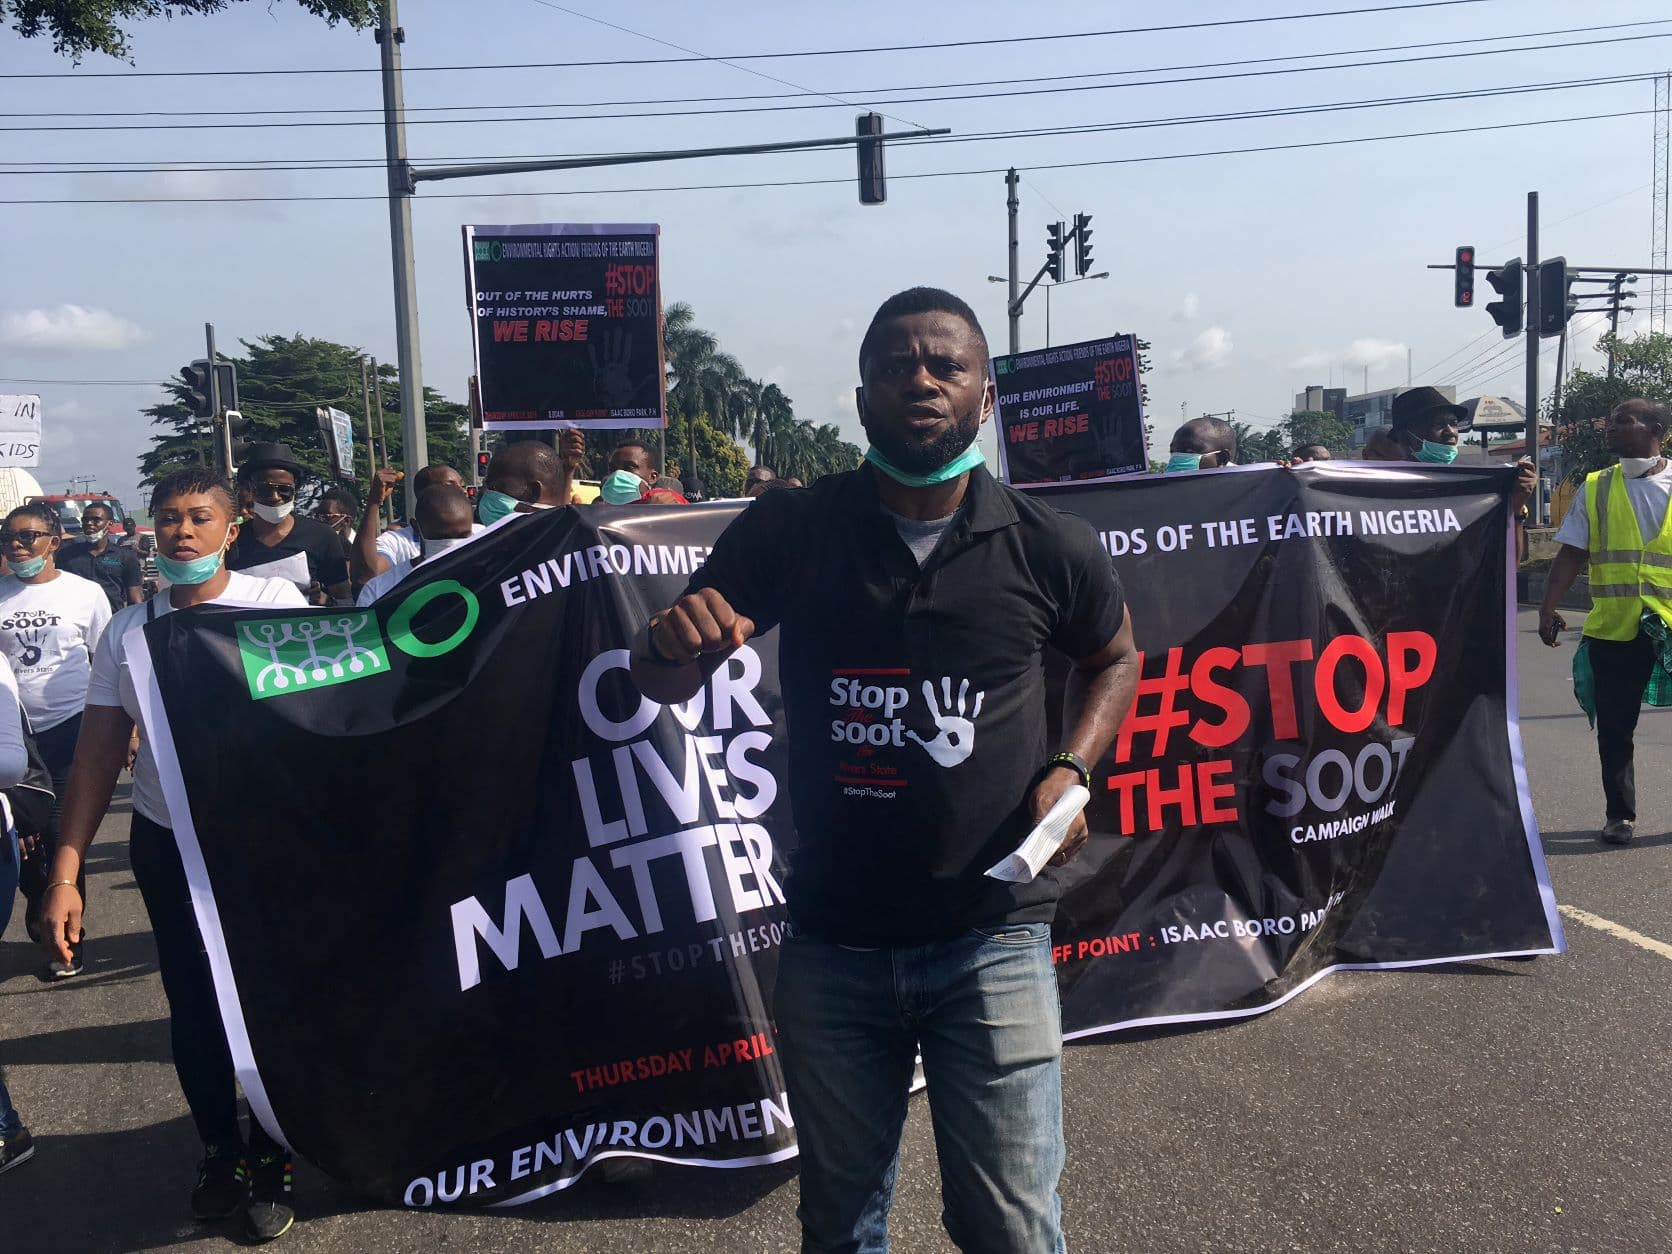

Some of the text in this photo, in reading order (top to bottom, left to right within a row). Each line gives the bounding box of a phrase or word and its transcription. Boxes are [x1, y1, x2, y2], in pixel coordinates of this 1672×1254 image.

[605, 264, 654, 296] #STOP
[477, 290, 593, 301] OUT OF THE HURTS
[607, 298, 653, 318] THE SOOT
[478, 305, 608, 318] OF HISTORY'S SHAME,
[493, 319, 589, 342] WE RISE
[1095, 357, 1132, 384] #STOP
[1000, 380, 1095, 406] OUR ENVIRONMENT
[14, 402, 36, 420] IN
[1020, 400, 1080, 419] IS OUR LIFE.
[1009, 413, 1089, 443] WE RISE
[500, 544, 713, 608] ENVIRONME
[1156, 525, 1193, 552] OF
[1201, 517, 1259, 549] THE
[1267, 510, 1353, 542] EARTH
[1360, 508, 1462, 536] NIGERIA
[1, 615, 62, 630] SOOT
[13, 610, 46, 618] STOP
[830, 677, 909, 718] Stop
[1115, 630, 1438, 763] #STOP
[831, 718, 906, 747] soot
[571, 730, 778, 848] LIVES
[843, 786, 897, 799] #StopTheSoot
[1107, 736, 1416, 835] THE SOOT
[1290, 800, 1396, 844] CAMPAIGN WALK
[450, 823, 787, 992] MATTER
[1052, 944, 1072, 965] FF
[1078, 932, 1140, 959] POINT
[1161, 920, 1229, 944] ISAAC
[1232, 916, 1295, 937] BORO
[571, 1032, 773, 1094] THURSDAY APRIL
[403, 1092, 795, 1208] OUR ENVIRONMEN
